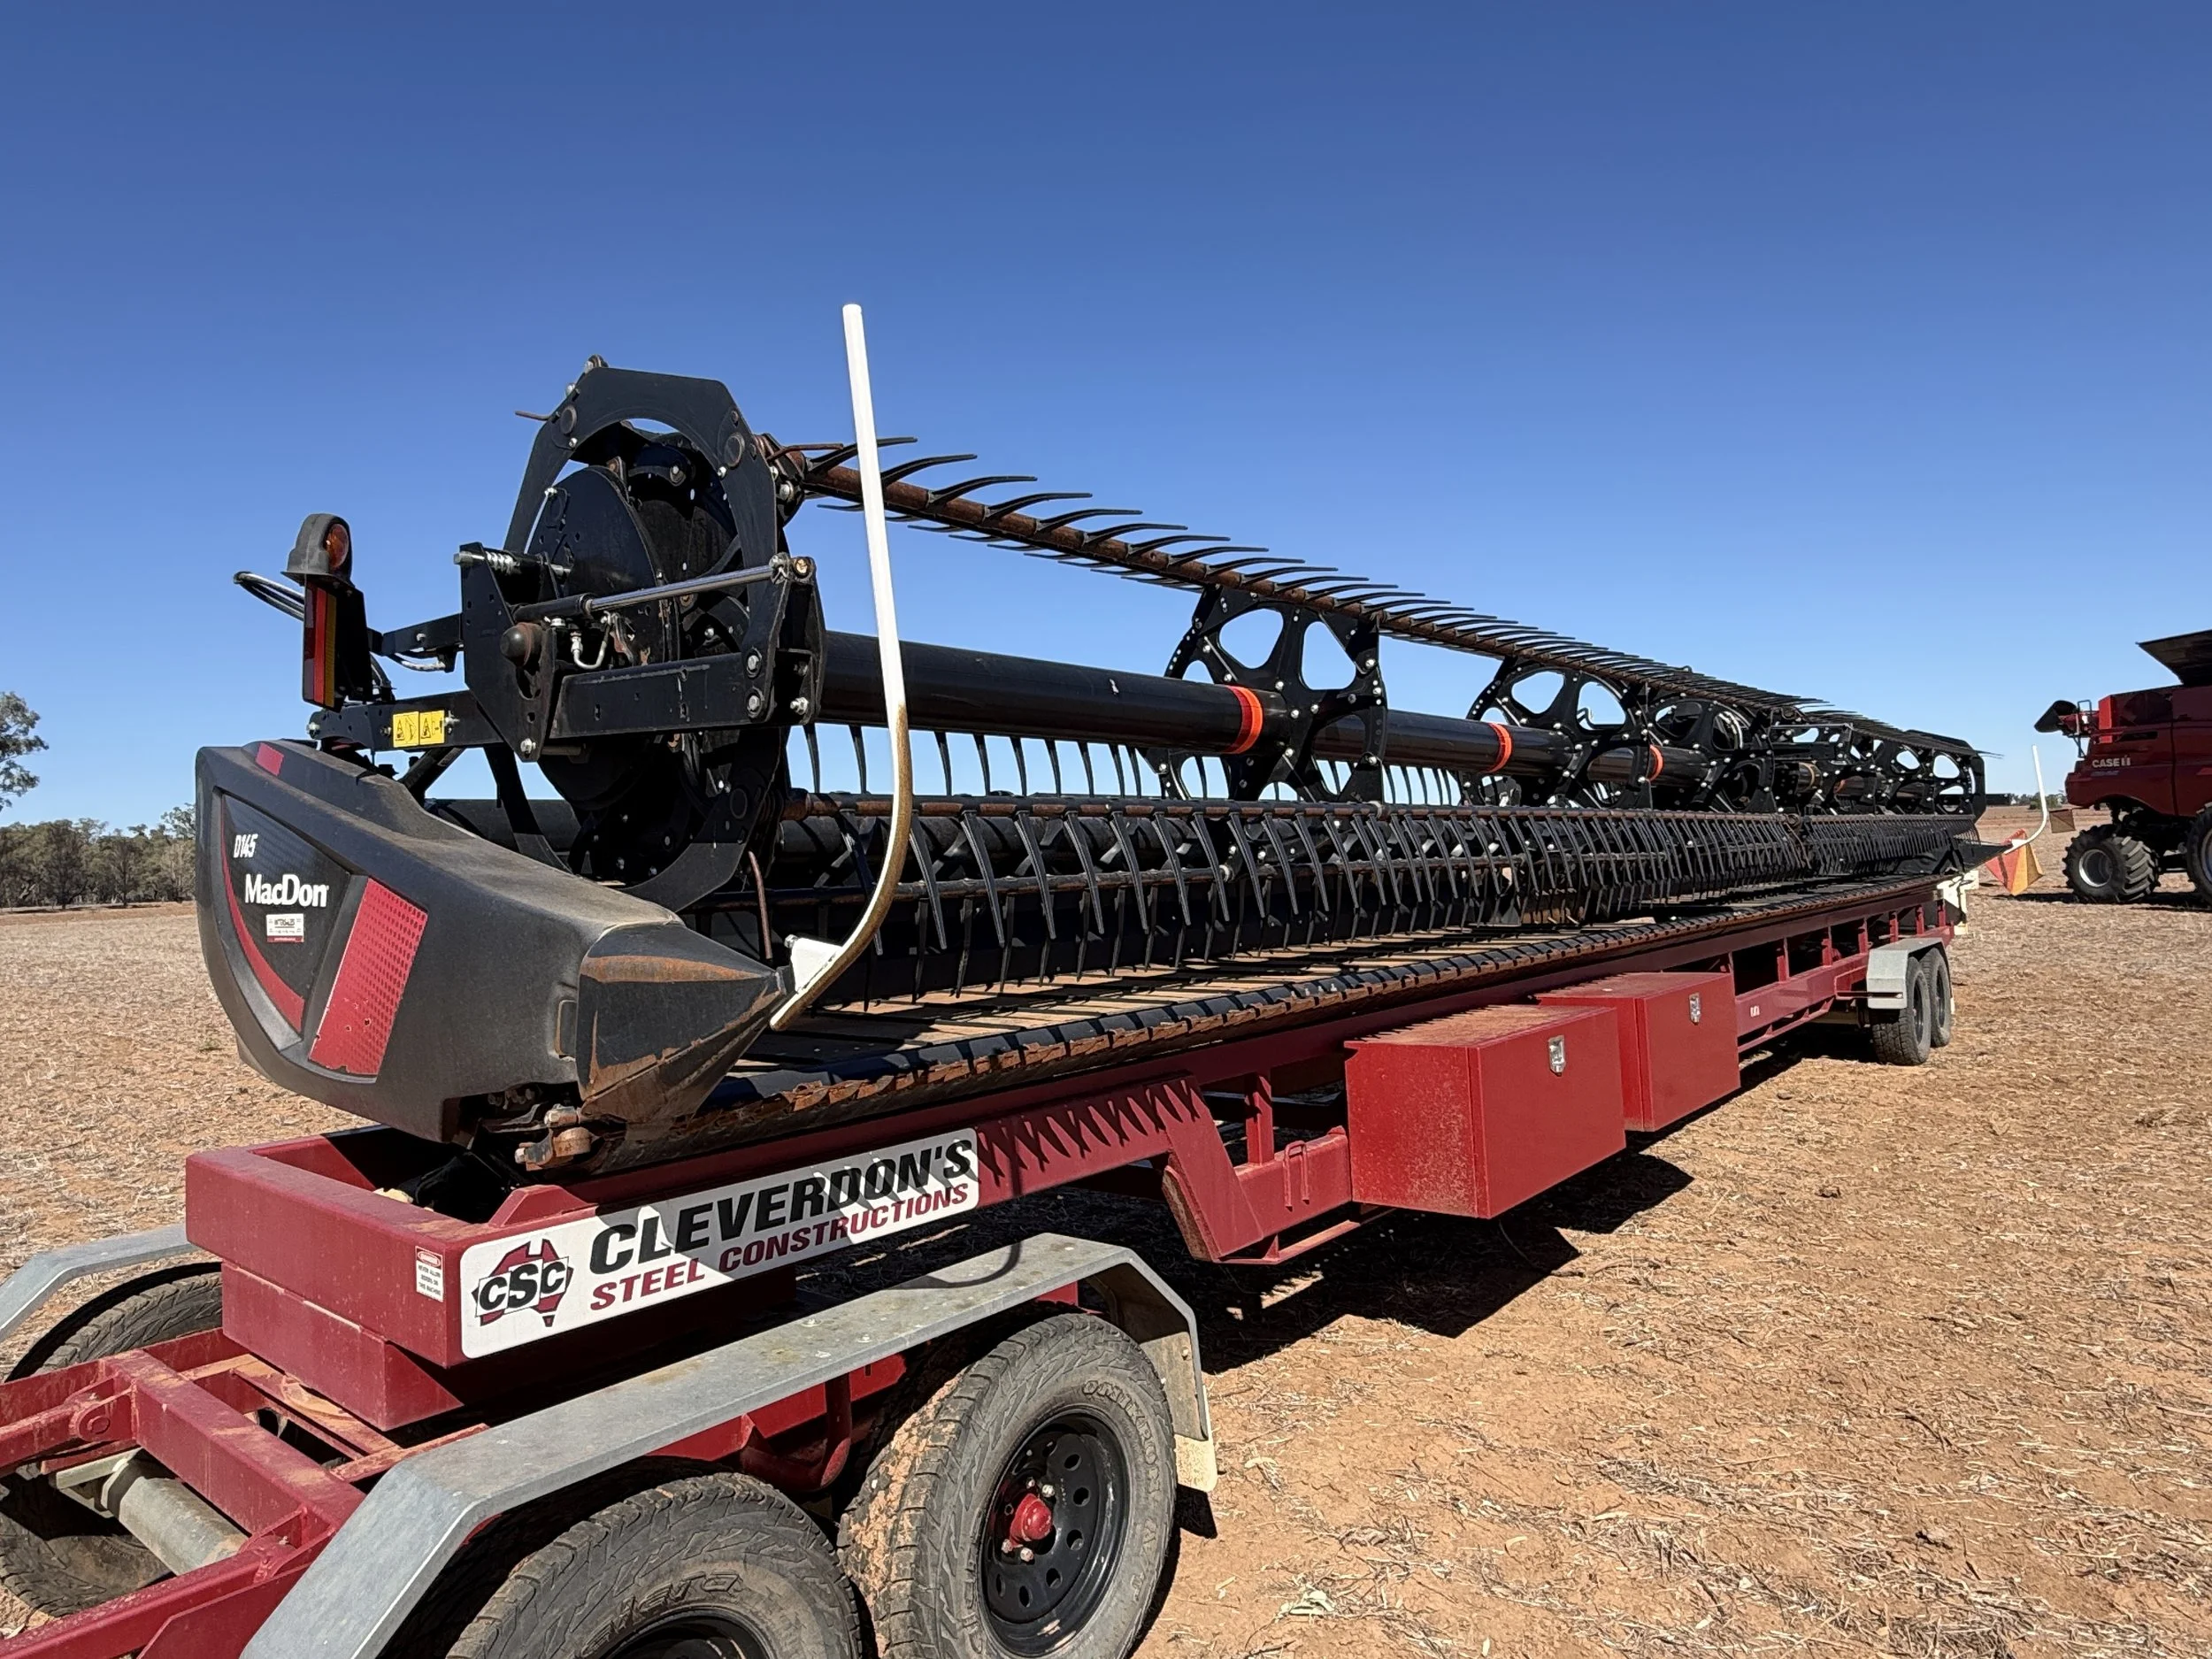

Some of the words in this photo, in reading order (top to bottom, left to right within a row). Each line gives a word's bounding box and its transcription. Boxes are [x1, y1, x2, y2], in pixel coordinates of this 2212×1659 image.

[2092, 757, 2120, 768] CASE
[233, 833, 259, 858] D145
[244, 873, 328, 908] MacDon
[589, 1139, 972, 1275] CLEVERDON'S
[589, 1257, 706, 1311] STEEL
[718, 1182, 969, 1273] CONSTRUCTIONS
[479, 1261, 566, 1311] CSC
